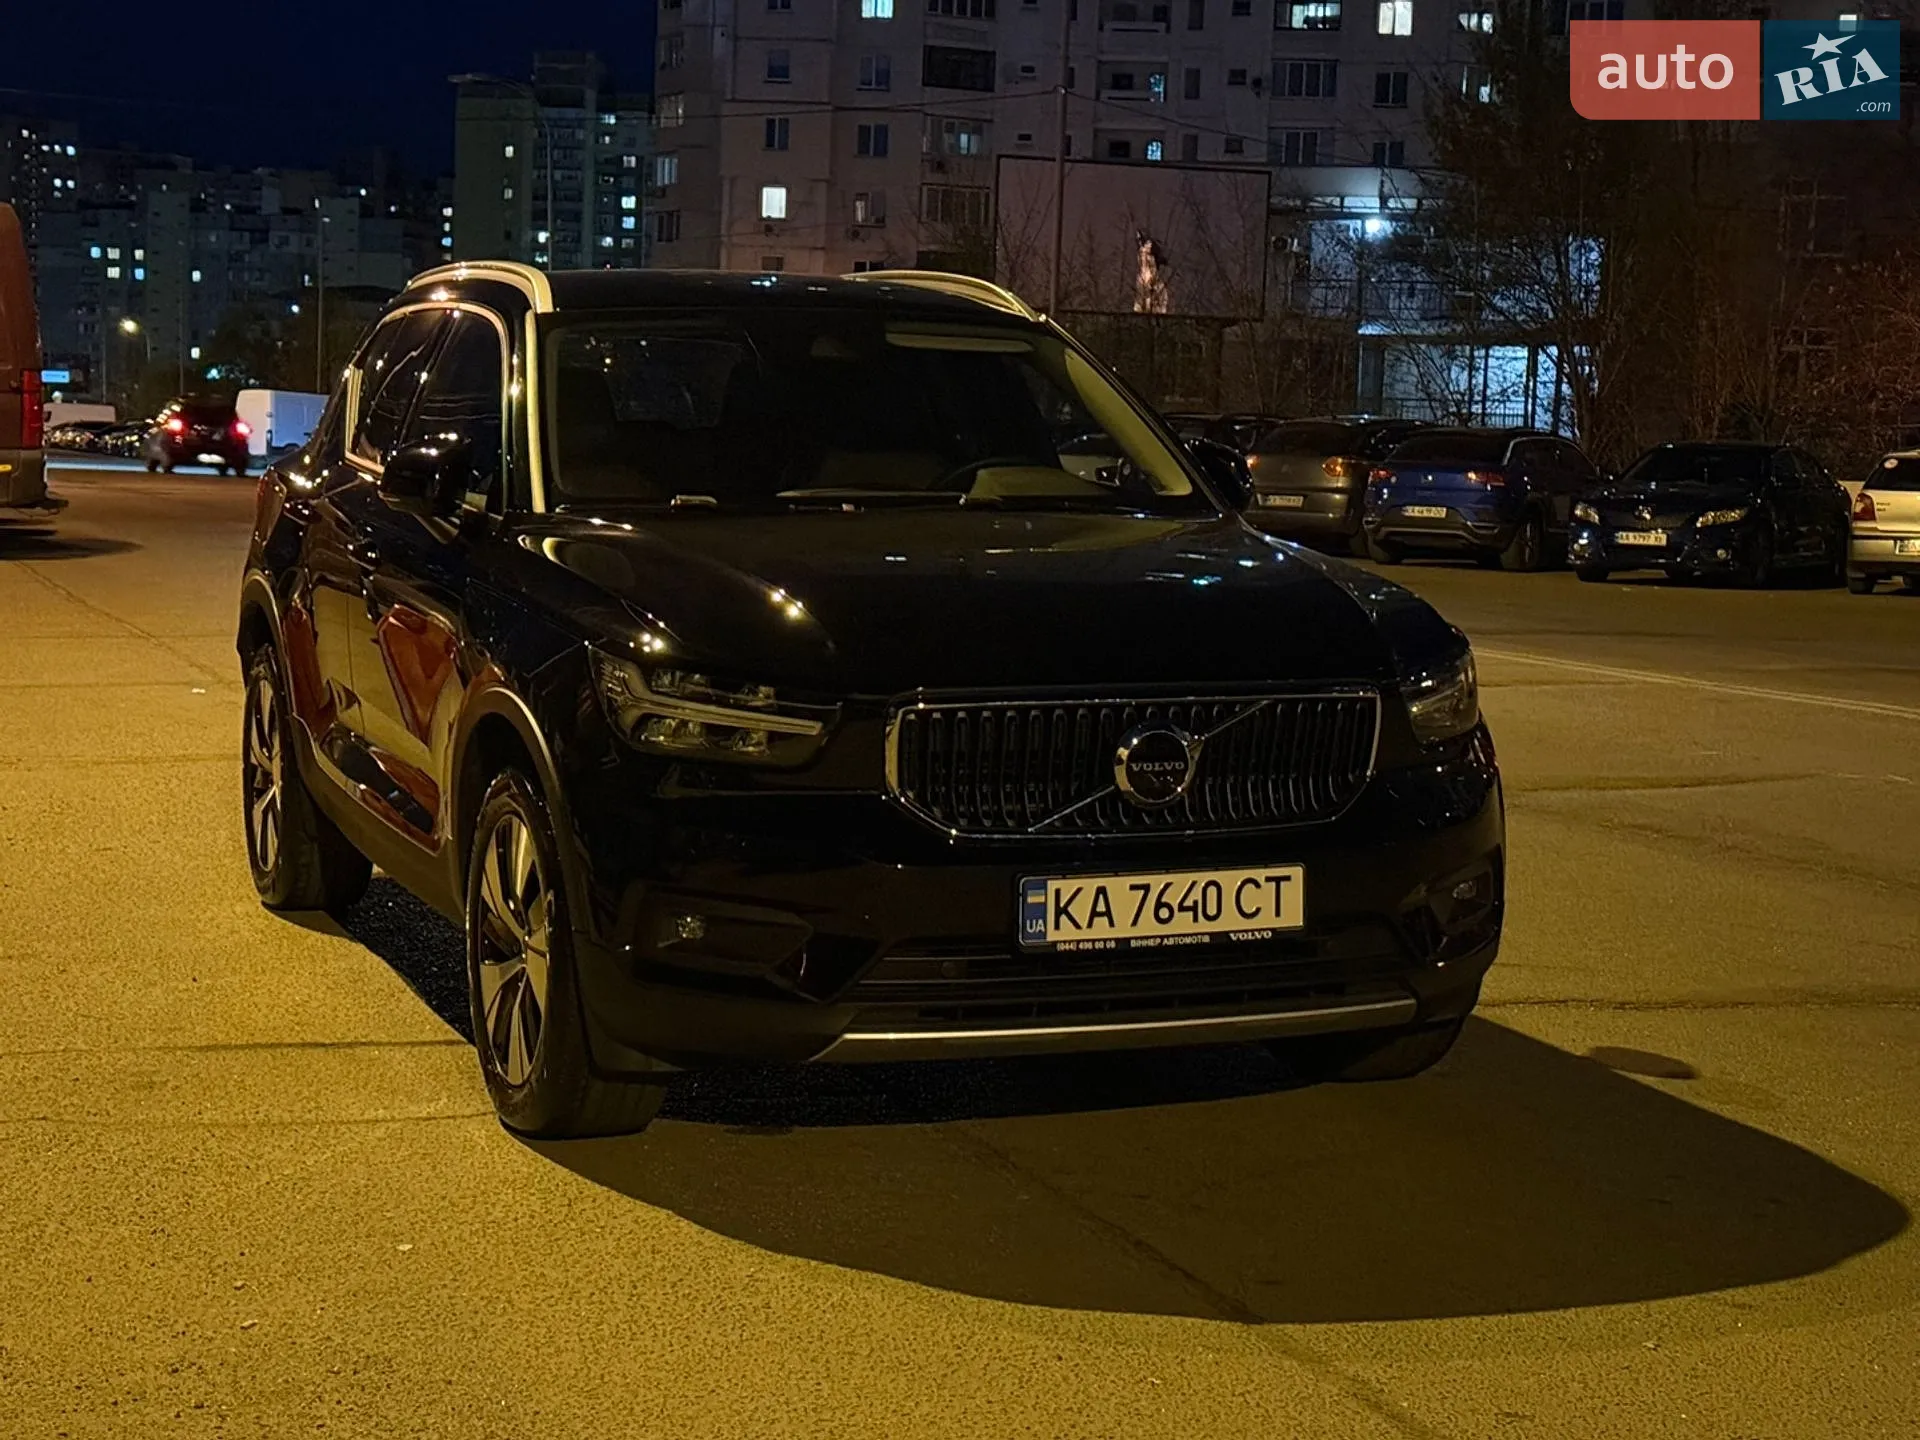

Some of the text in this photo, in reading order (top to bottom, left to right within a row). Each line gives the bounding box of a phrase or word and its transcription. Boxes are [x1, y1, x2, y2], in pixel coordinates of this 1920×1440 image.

[1130, 761, 1185, 772] VOLVO
[1053, 874, 1292, 931] KA 7640 CT
[1026, 919, 1045, 933] UA
[1229, 930, 1272, 941] VOLVO
